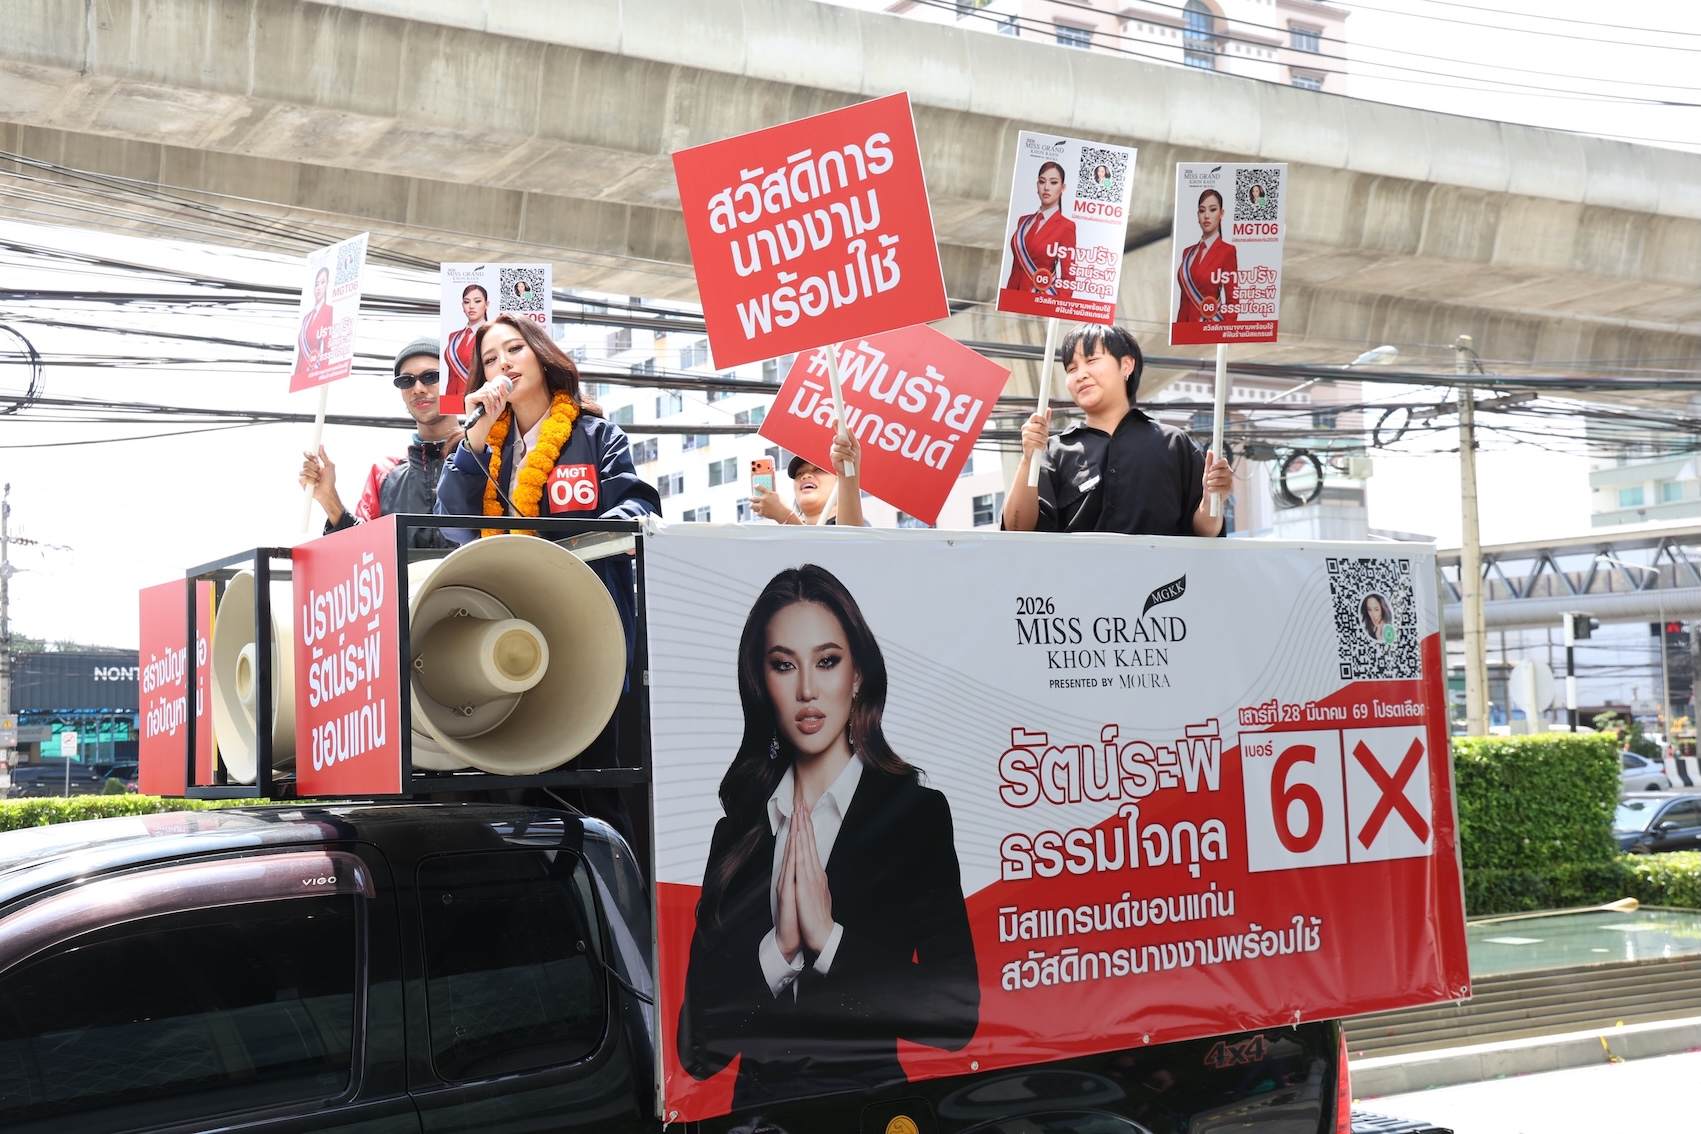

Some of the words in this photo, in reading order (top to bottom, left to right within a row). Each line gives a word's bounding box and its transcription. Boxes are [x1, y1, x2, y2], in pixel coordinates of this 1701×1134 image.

[707, 132, 894, 234] สวัสดิการ
[1074, 199, 1123, 218] MGT06
[730, 188, 881, 277] นางงาม
[1233, 223, 1278, 235] MGT06
[736, 234, 901, 341] พร้อมใช้
[1036, 275, 1049, 284] 06
[1202, 303, 1215, 312] 06
[556, 467, 587, 479] MGT
[551, 479, 595, 506] 06
[303, 551, 384, 646] ปรางปรัง
[1016, 596, 1055, 615] 2026
[1151, 580, 1185, 604] MGKK
[1015, 617, 1083, 645] MISS
[1093, 616, 1187, 644] GRAND
[309, 613, 380, 708] รัตน์ระพี
[1048, 650, 1106, 669] KHON
[1114, 648, 1169, 667] KAEN
[1049, 678, 1098, 689] PRESENTED
[1101, 677, 1113, 687] BY
[1119, 673, 1171, 689] MOURA
[1240, 700, 1277, 724] เสาร์ที่
[1283, 706, 1300, 721] 28
[1306, 703, 1347, 721] มีนาคม
[1352, 703, 1368, 719] 69
[312, 685, 386, 772] ขอนแก่น
[1245, 740, 1273, 757] เบอร์
[999, 719, 1222, 808] รัตน์ระพี
[1270, 744, 1324, 854] 6
[1000, 802, 1228, 880] ธรรมใจกุล
[302, 876, 337, 886] VIGO
[998, 882, 1235, 943] มิสแกรนด์ขอนแก่น
[1001, 915, 1322, 991] สวัสดิการนางงามพร้อมใช้
[1204, 1034, 1268, 1069] 4x4
